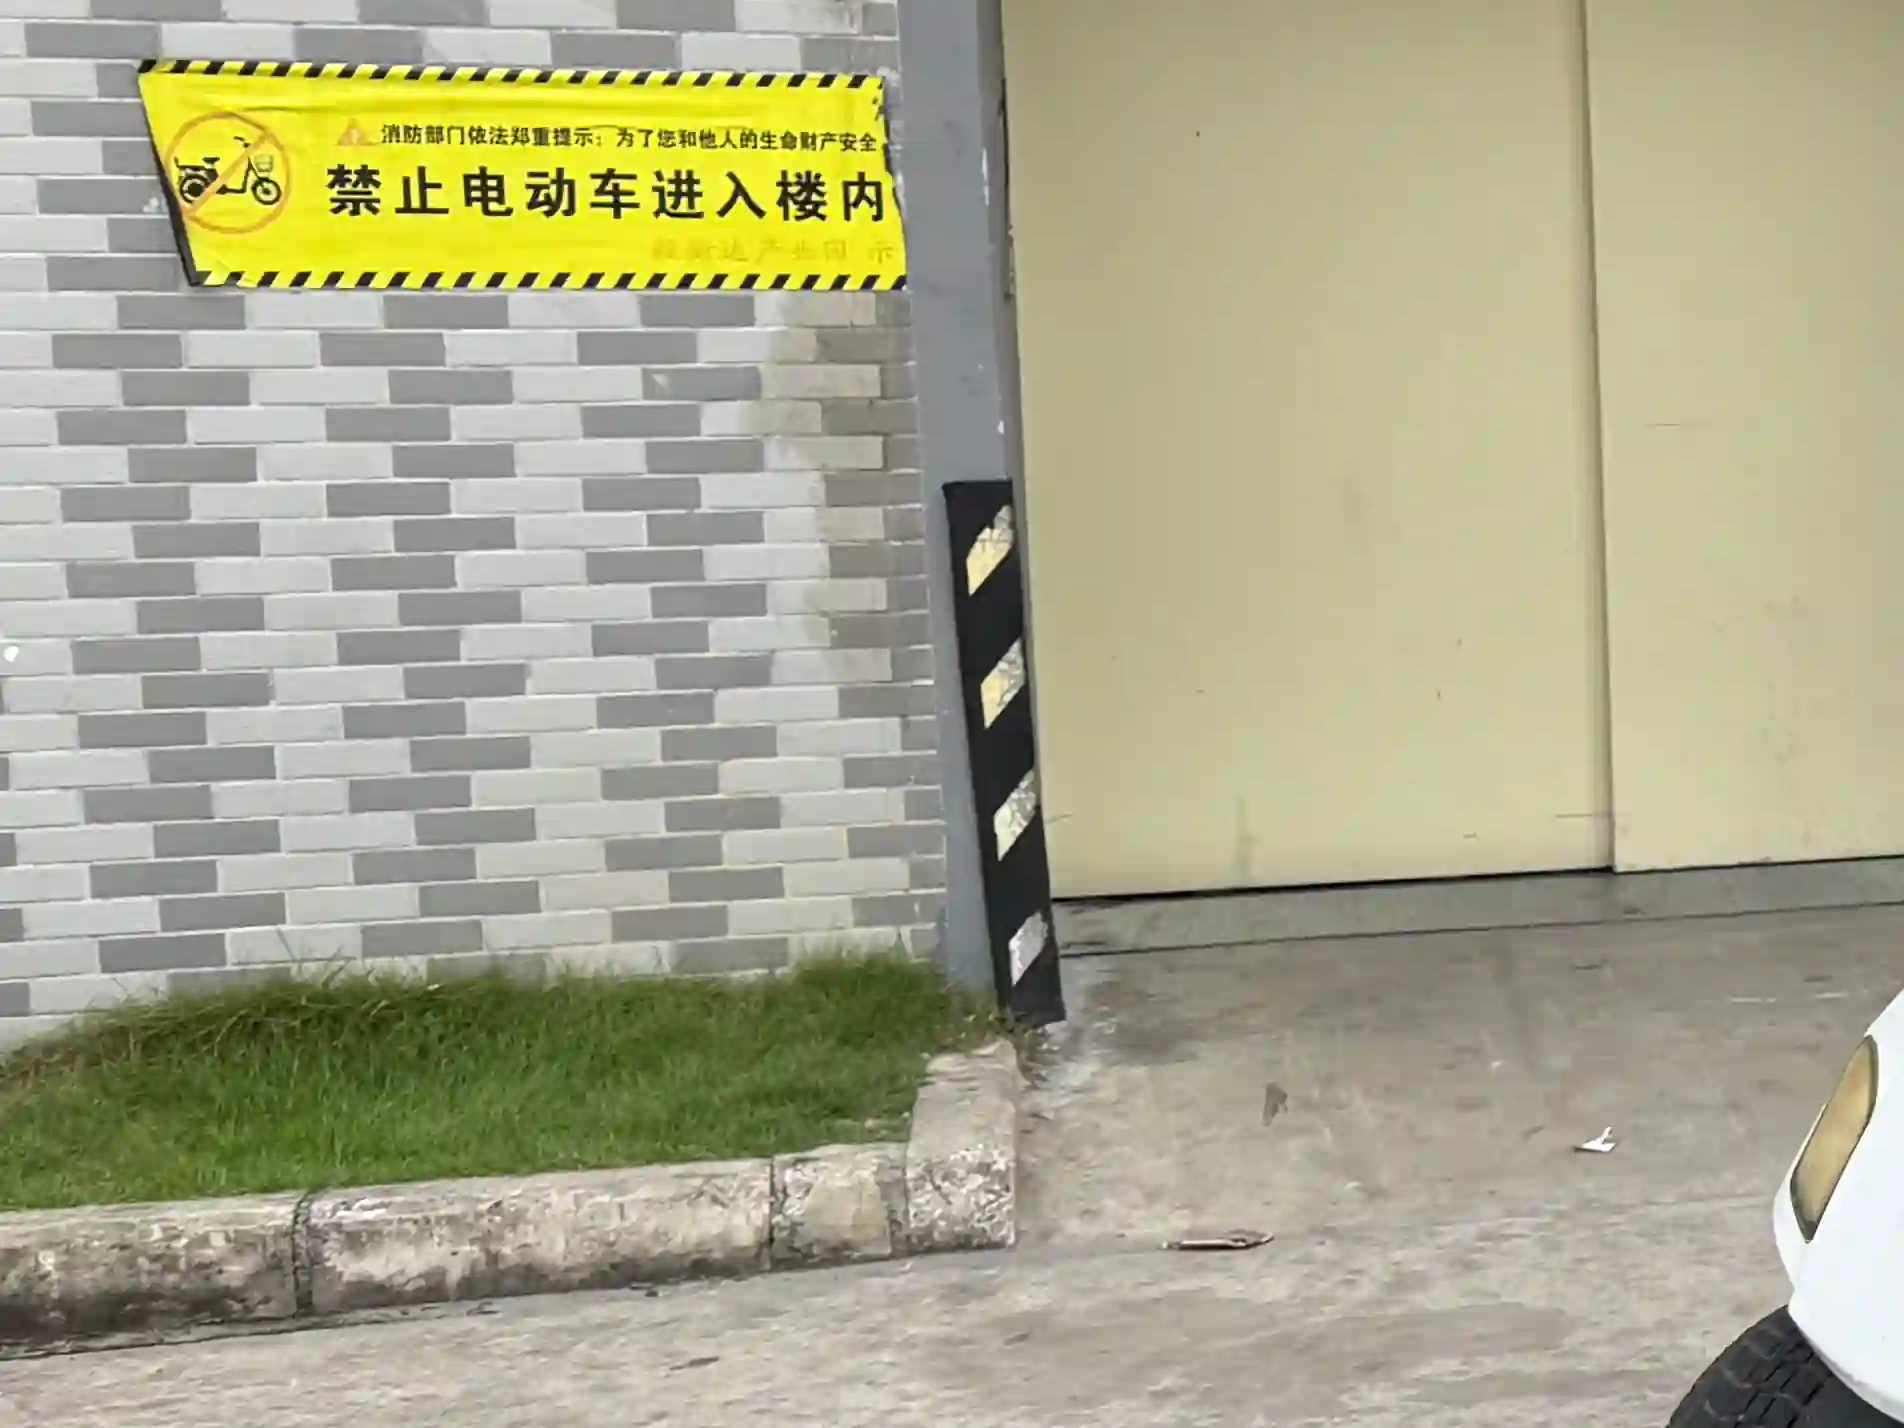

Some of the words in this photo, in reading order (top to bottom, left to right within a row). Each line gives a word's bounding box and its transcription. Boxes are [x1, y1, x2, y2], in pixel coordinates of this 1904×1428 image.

[326, 163, 886, 223] 禁止电动车进入楼内
